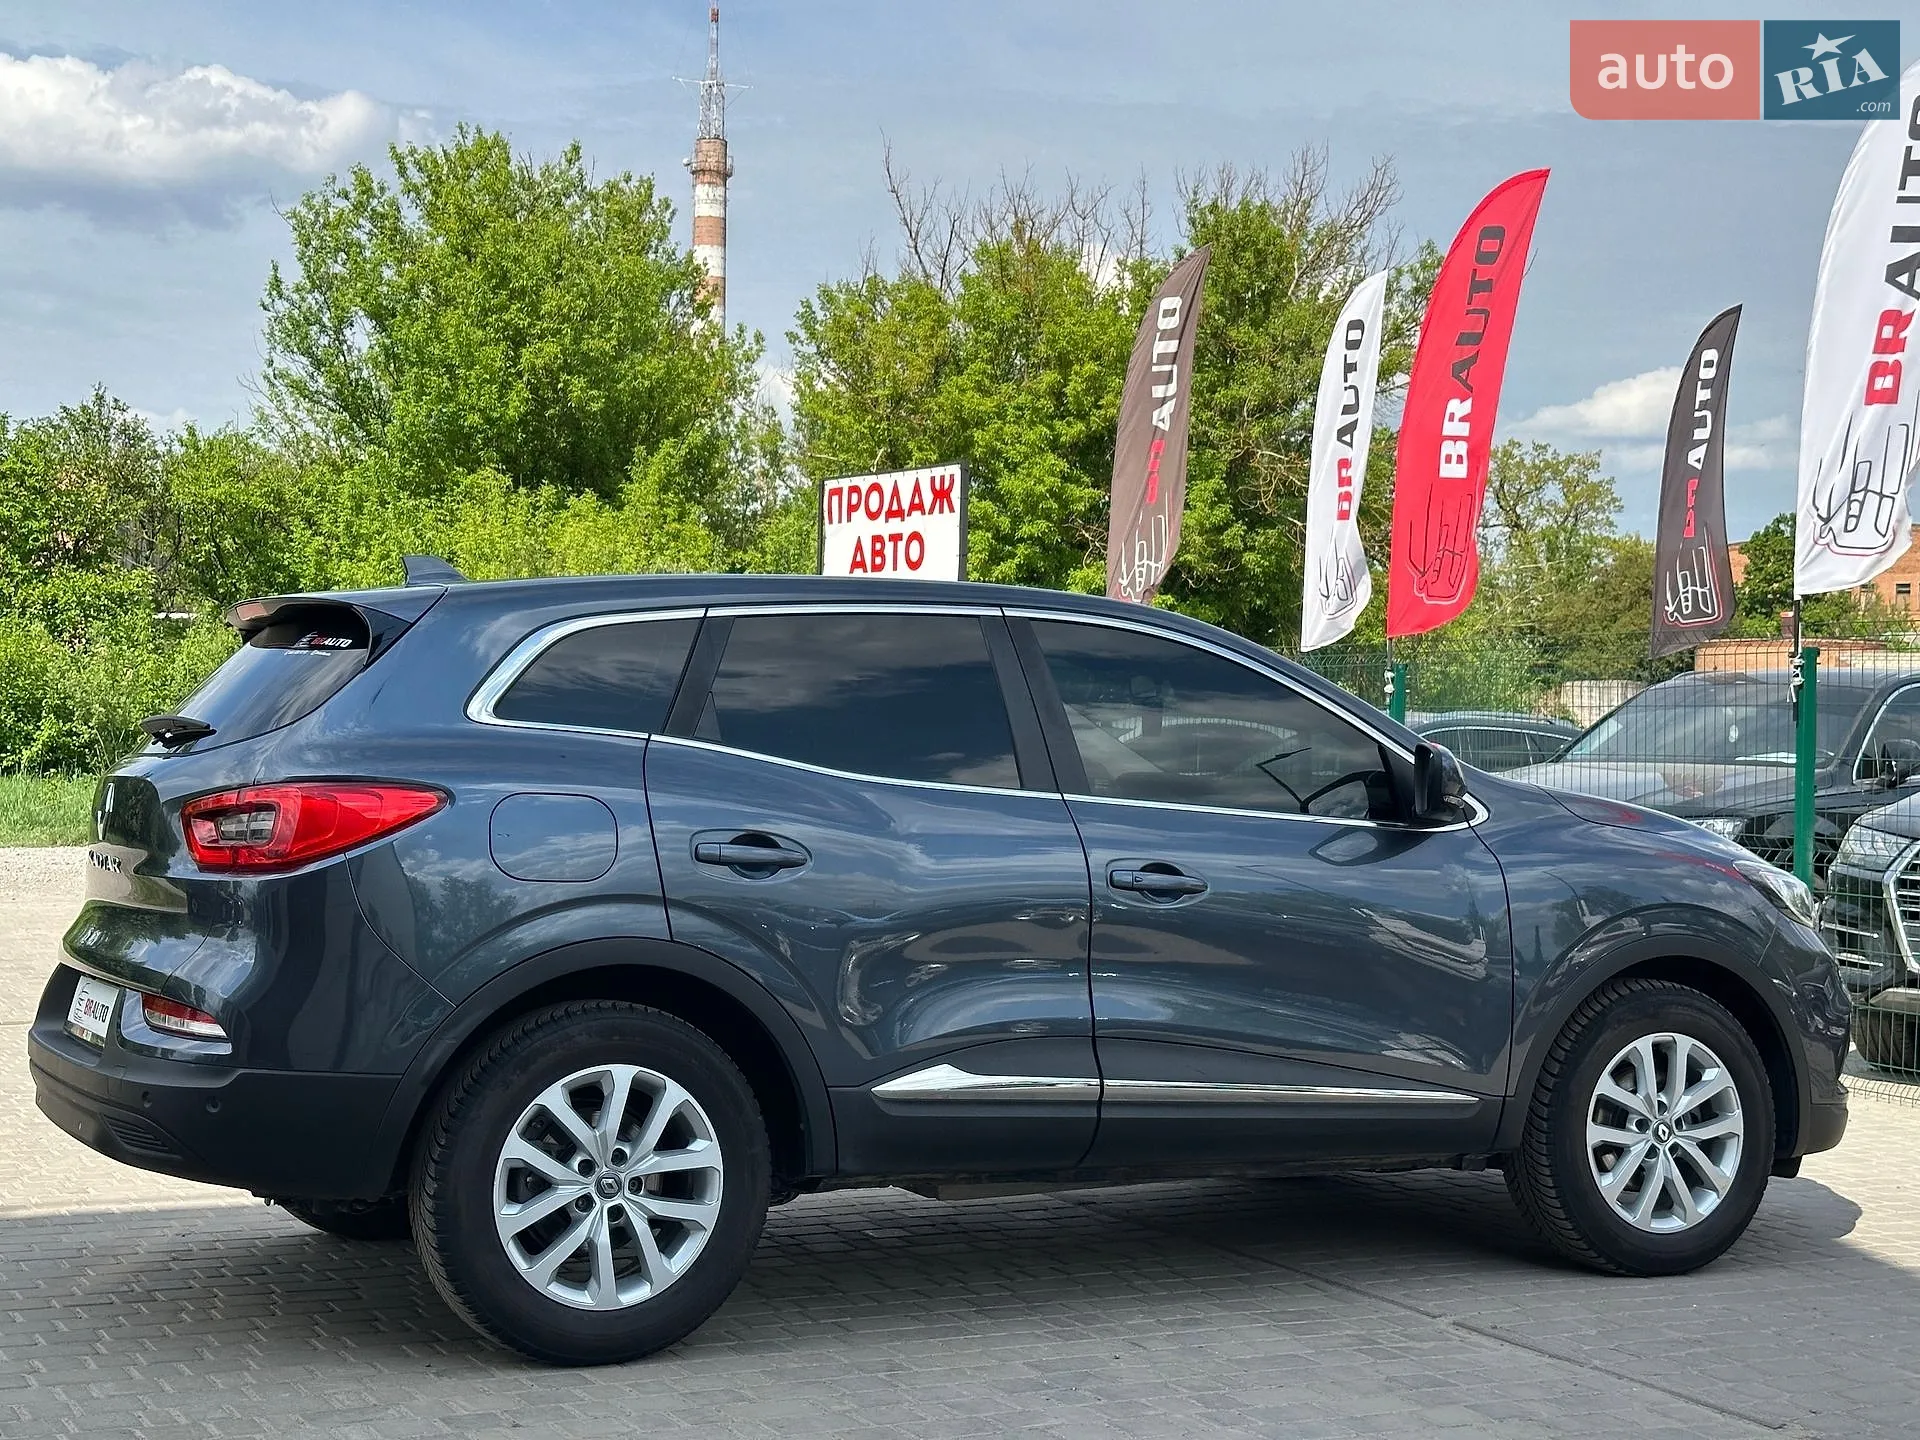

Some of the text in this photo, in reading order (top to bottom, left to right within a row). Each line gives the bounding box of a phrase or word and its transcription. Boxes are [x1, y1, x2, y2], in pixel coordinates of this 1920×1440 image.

[1438, 223, 1507, 479] BRAUTO
[1336, 318, 1365, 521] BRAUTO
[828, 474, 956, 525] ПРОДАЖ
[849, 531, 925, 575] АВТО
